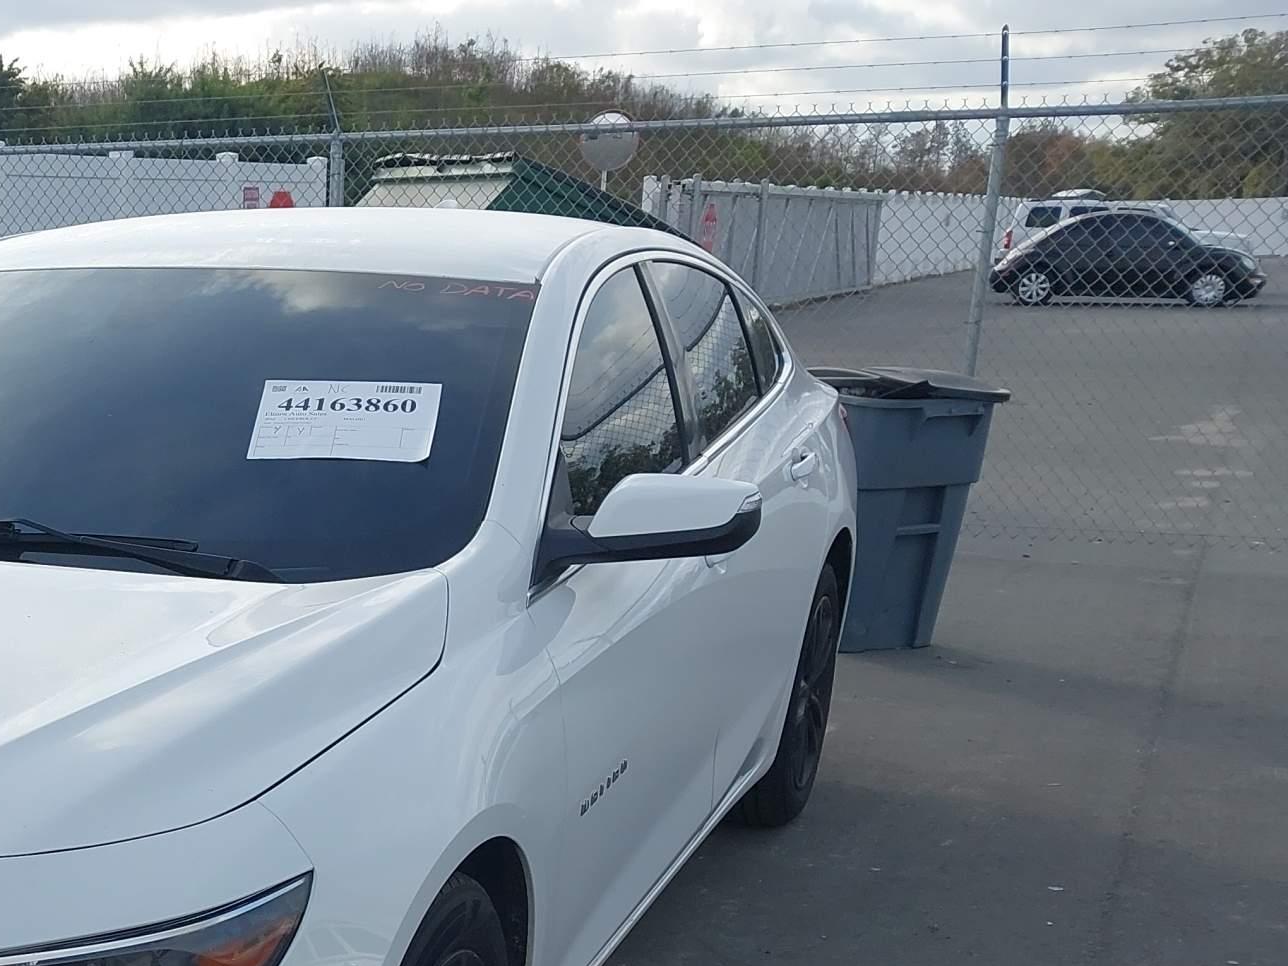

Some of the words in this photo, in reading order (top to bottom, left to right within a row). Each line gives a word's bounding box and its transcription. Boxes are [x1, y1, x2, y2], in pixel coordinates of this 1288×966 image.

[378, 280, 425, 292] NO
[440, 282, 535, 301] DATA
[277, 397, 417, 413] 44163860
